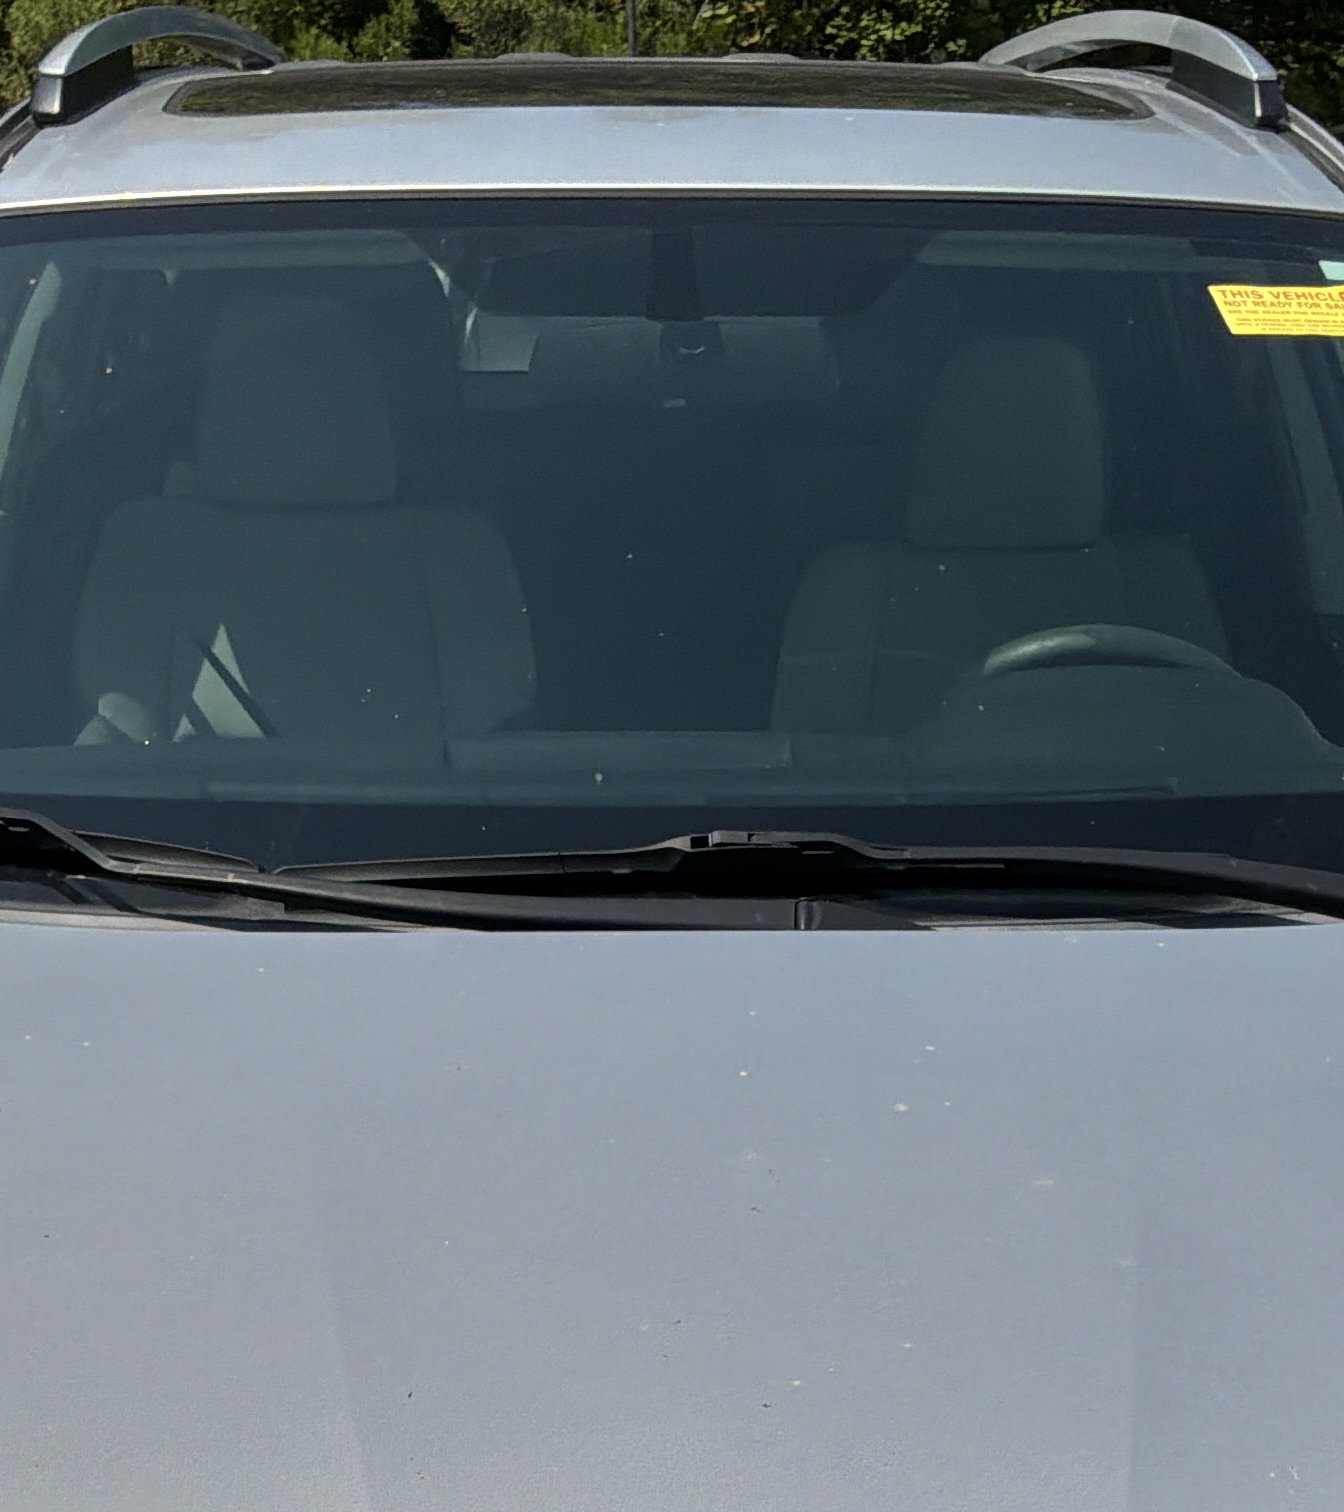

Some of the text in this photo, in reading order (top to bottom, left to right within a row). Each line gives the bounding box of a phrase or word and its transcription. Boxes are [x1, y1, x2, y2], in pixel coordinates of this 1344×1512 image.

[1216, 289, 1265, 300] THIS
[1251, 300, 1293, 308] READY
[1296, 301, 1322, 309] FOR
